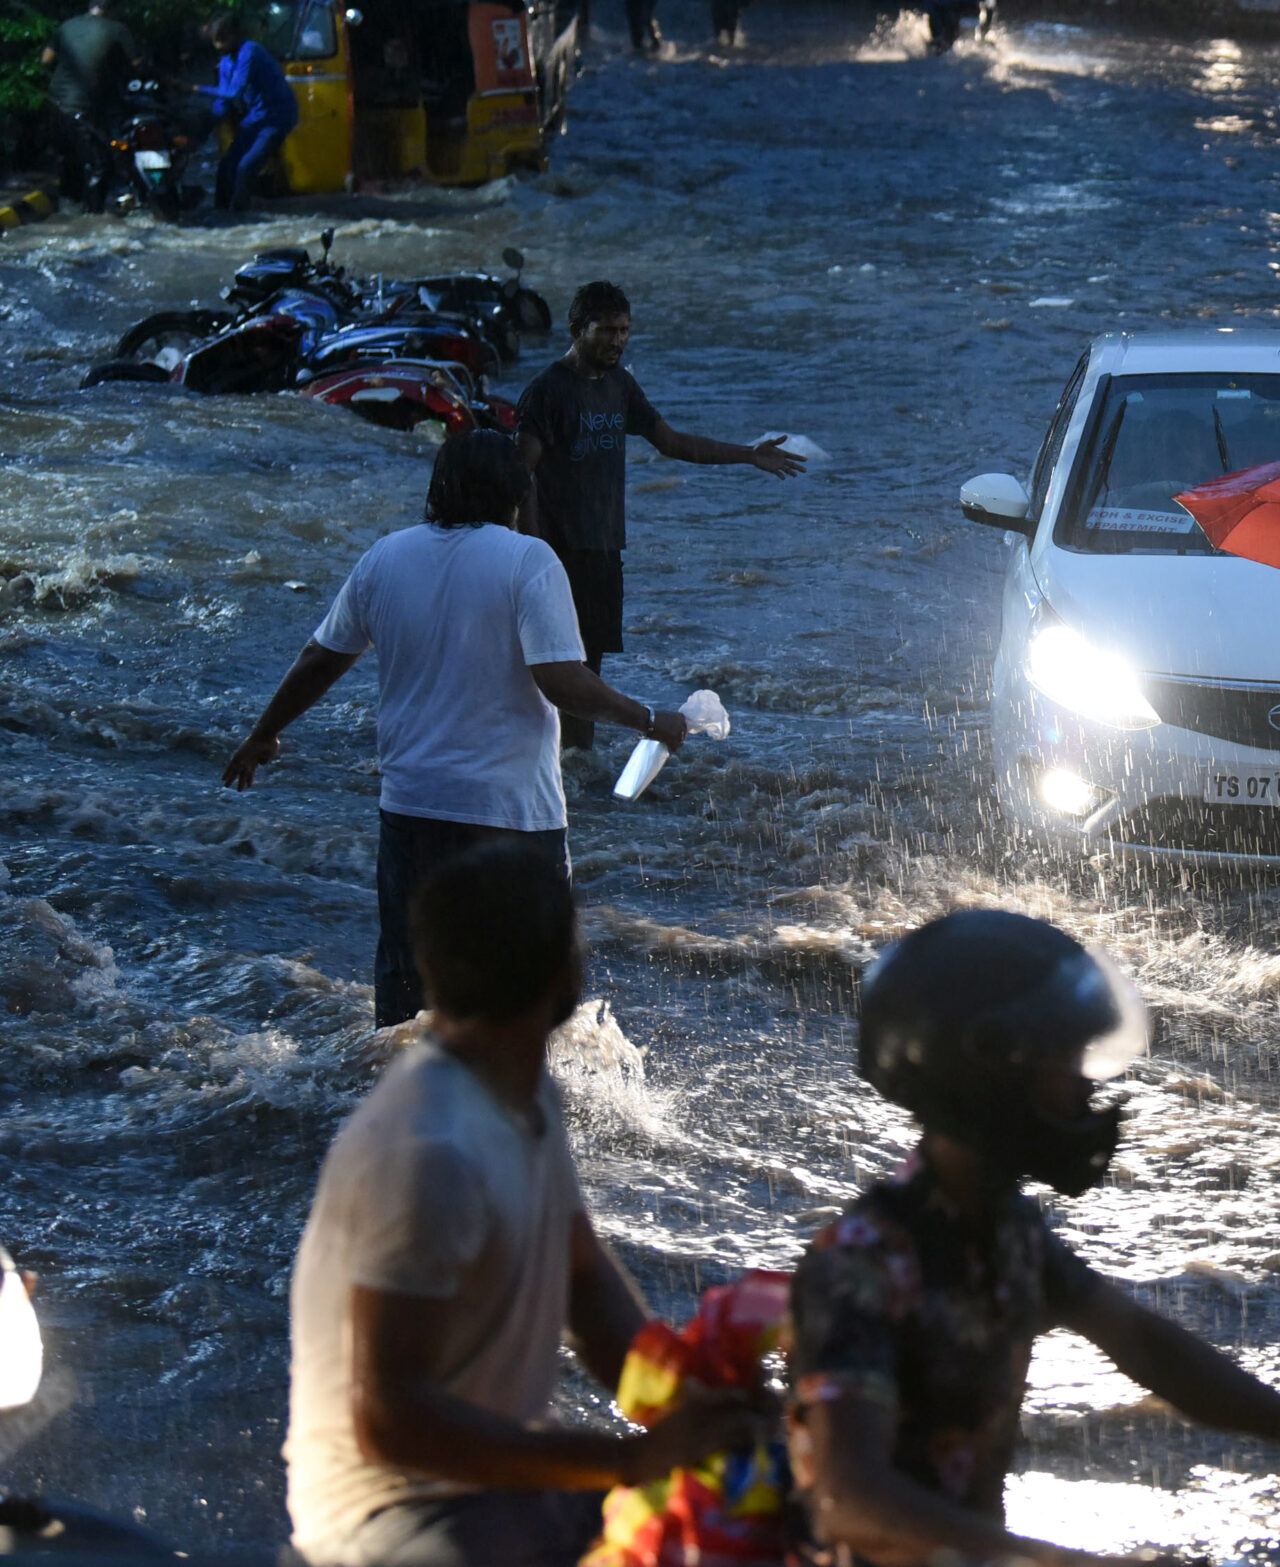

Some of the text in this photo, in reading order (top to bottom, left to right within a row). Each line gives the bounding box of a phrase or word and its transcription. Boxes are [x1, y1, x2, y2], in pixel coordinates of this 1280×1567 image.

[1137, 513, 1188, 525] EXCISE
[1214, 775, 1240, 797] TS
[1246, 776, 1271, 799] 07
